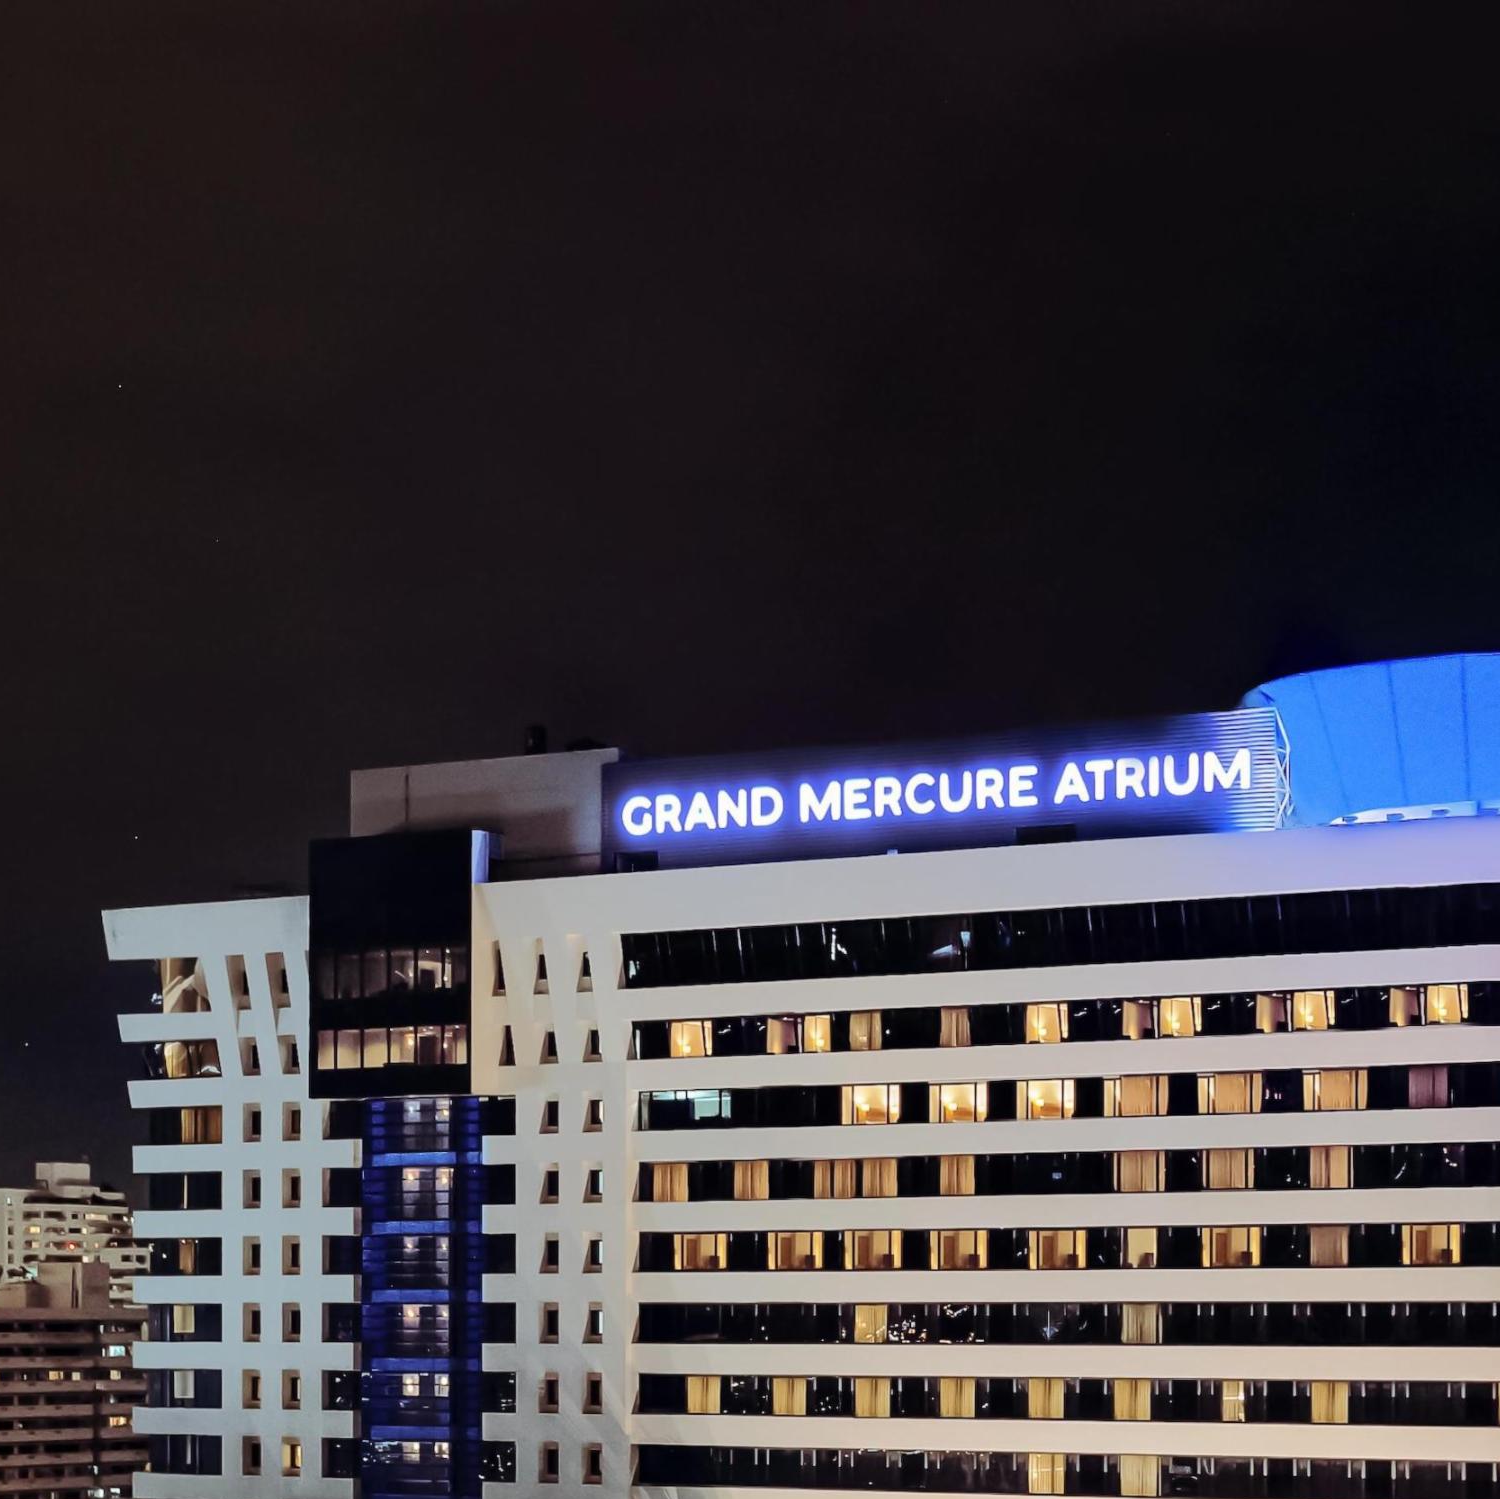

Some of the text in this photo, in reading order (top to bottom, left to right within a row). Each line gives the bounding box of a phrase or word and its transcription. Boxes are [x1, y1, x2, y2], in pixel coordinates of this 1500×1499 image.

[621, 748, 1251, 836] GRAND MERCURE ATRIUM
